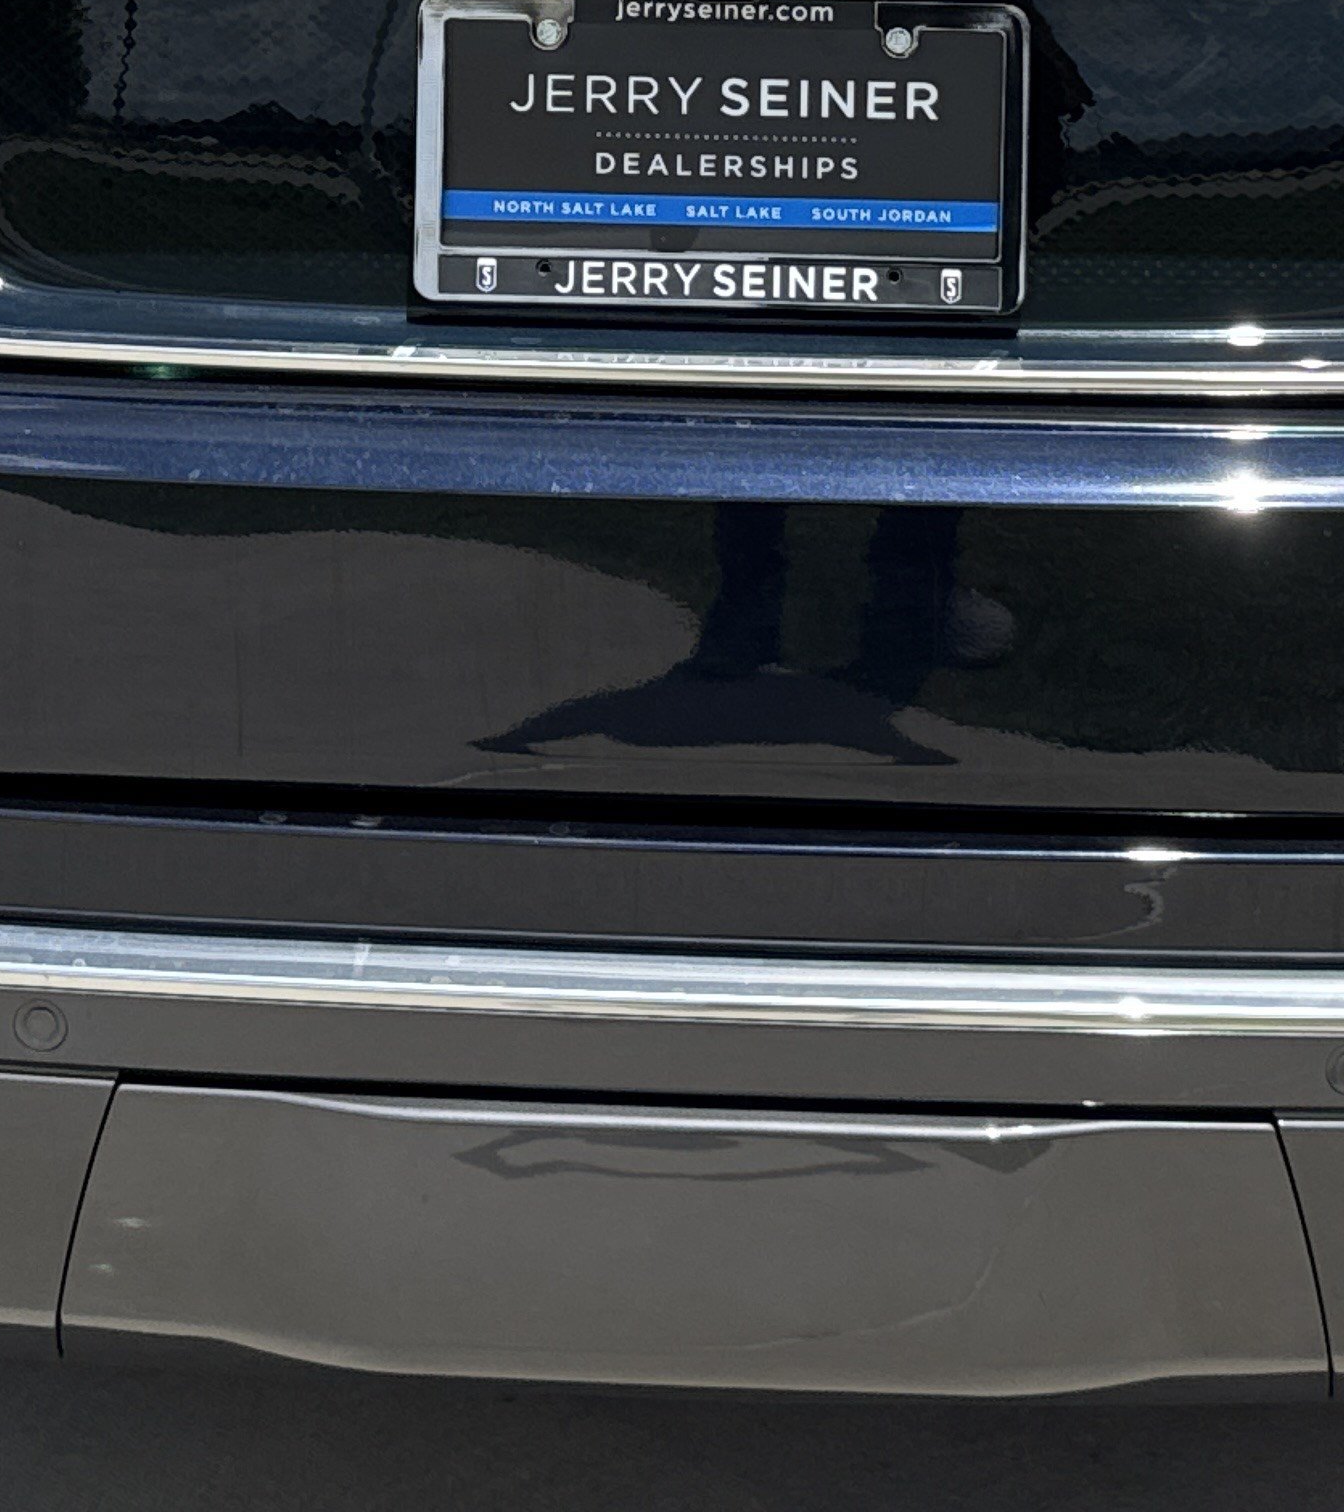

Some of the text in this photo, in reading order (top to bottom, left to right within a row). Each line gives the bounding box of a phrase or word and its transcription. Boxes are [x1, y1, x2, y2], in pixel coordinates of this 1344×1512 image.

[509, 73, 940, 121] JERRY SEINER
[595, 152, 858, 180] DEALERSHIPS
[493, 199, 952, 223] NORTH SALT LAKE SALT LAKE SOUTH JORDAN
[554, 261, 879, 302] JERRY SEINER
